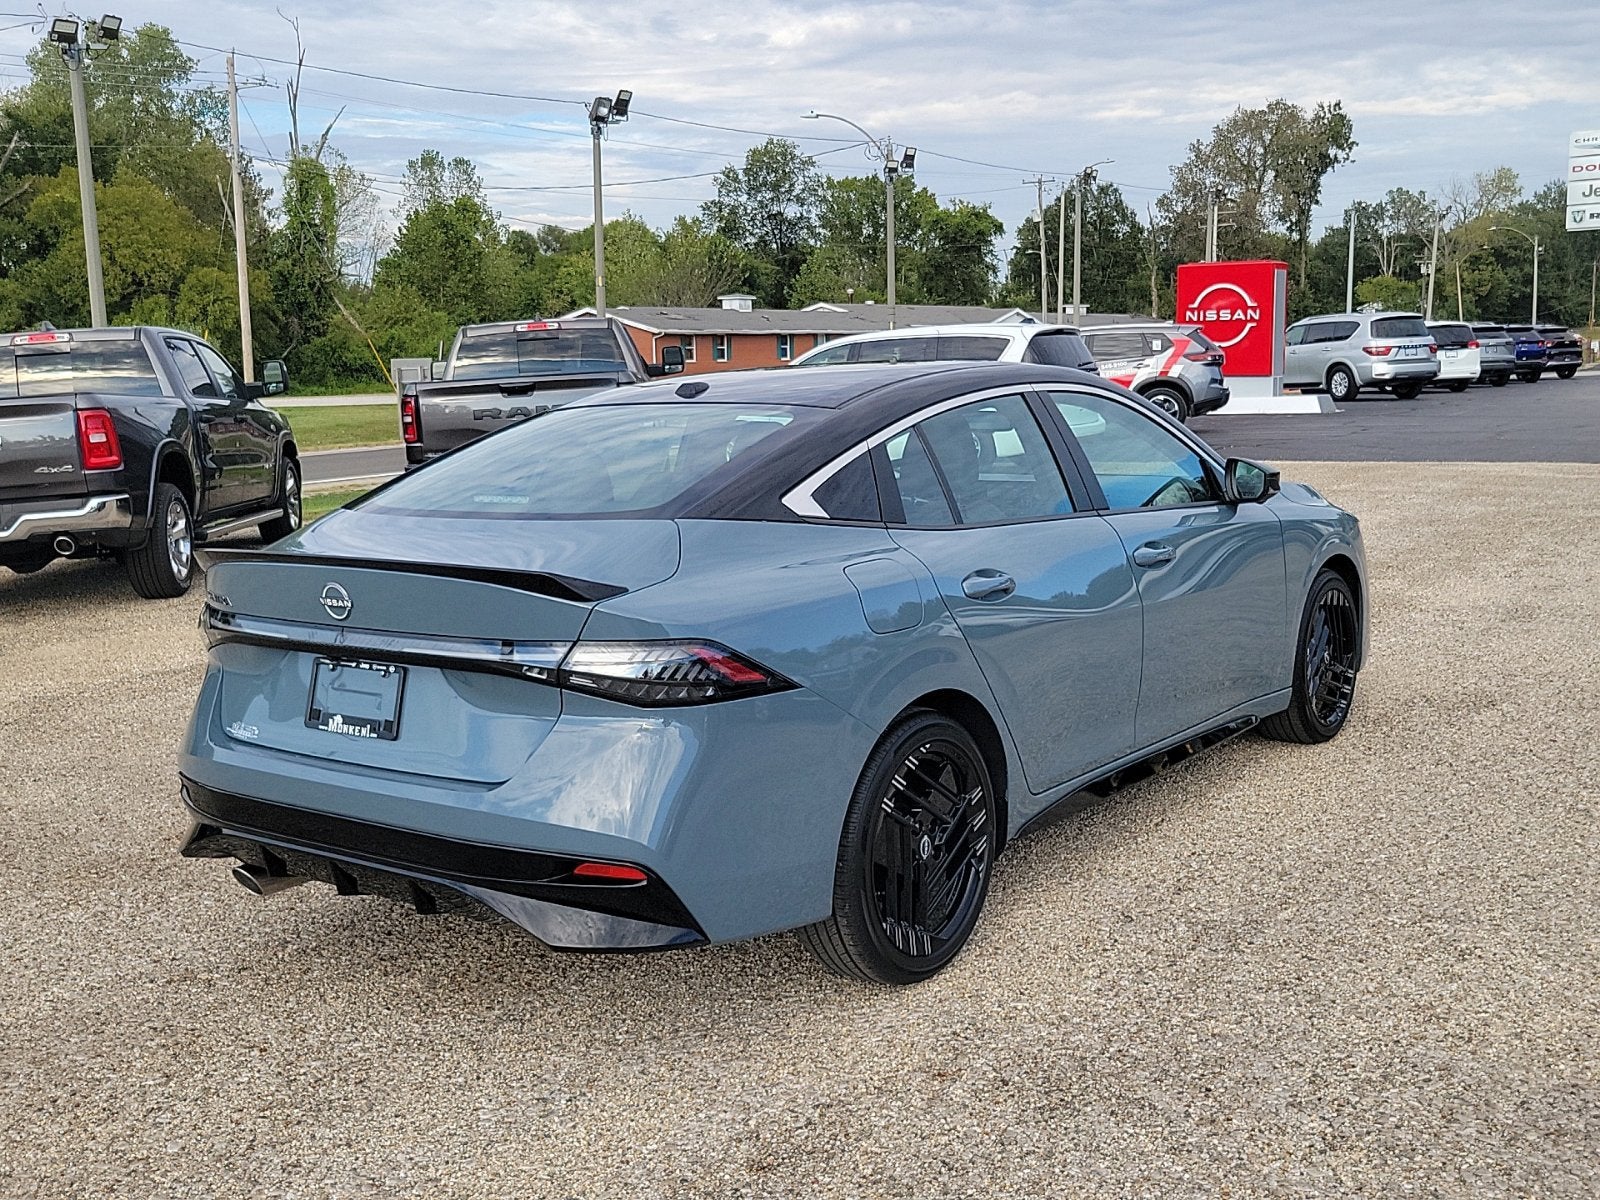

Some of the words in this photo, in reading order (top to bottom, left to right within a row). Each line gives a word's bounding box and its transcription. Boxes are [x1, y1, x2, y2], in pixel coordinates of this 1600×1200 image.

[1572, 164, 1600, 172] DO
[1185, 308, 1260, 321] NISSAN
[319, 597, 352, 608] NISSAN
